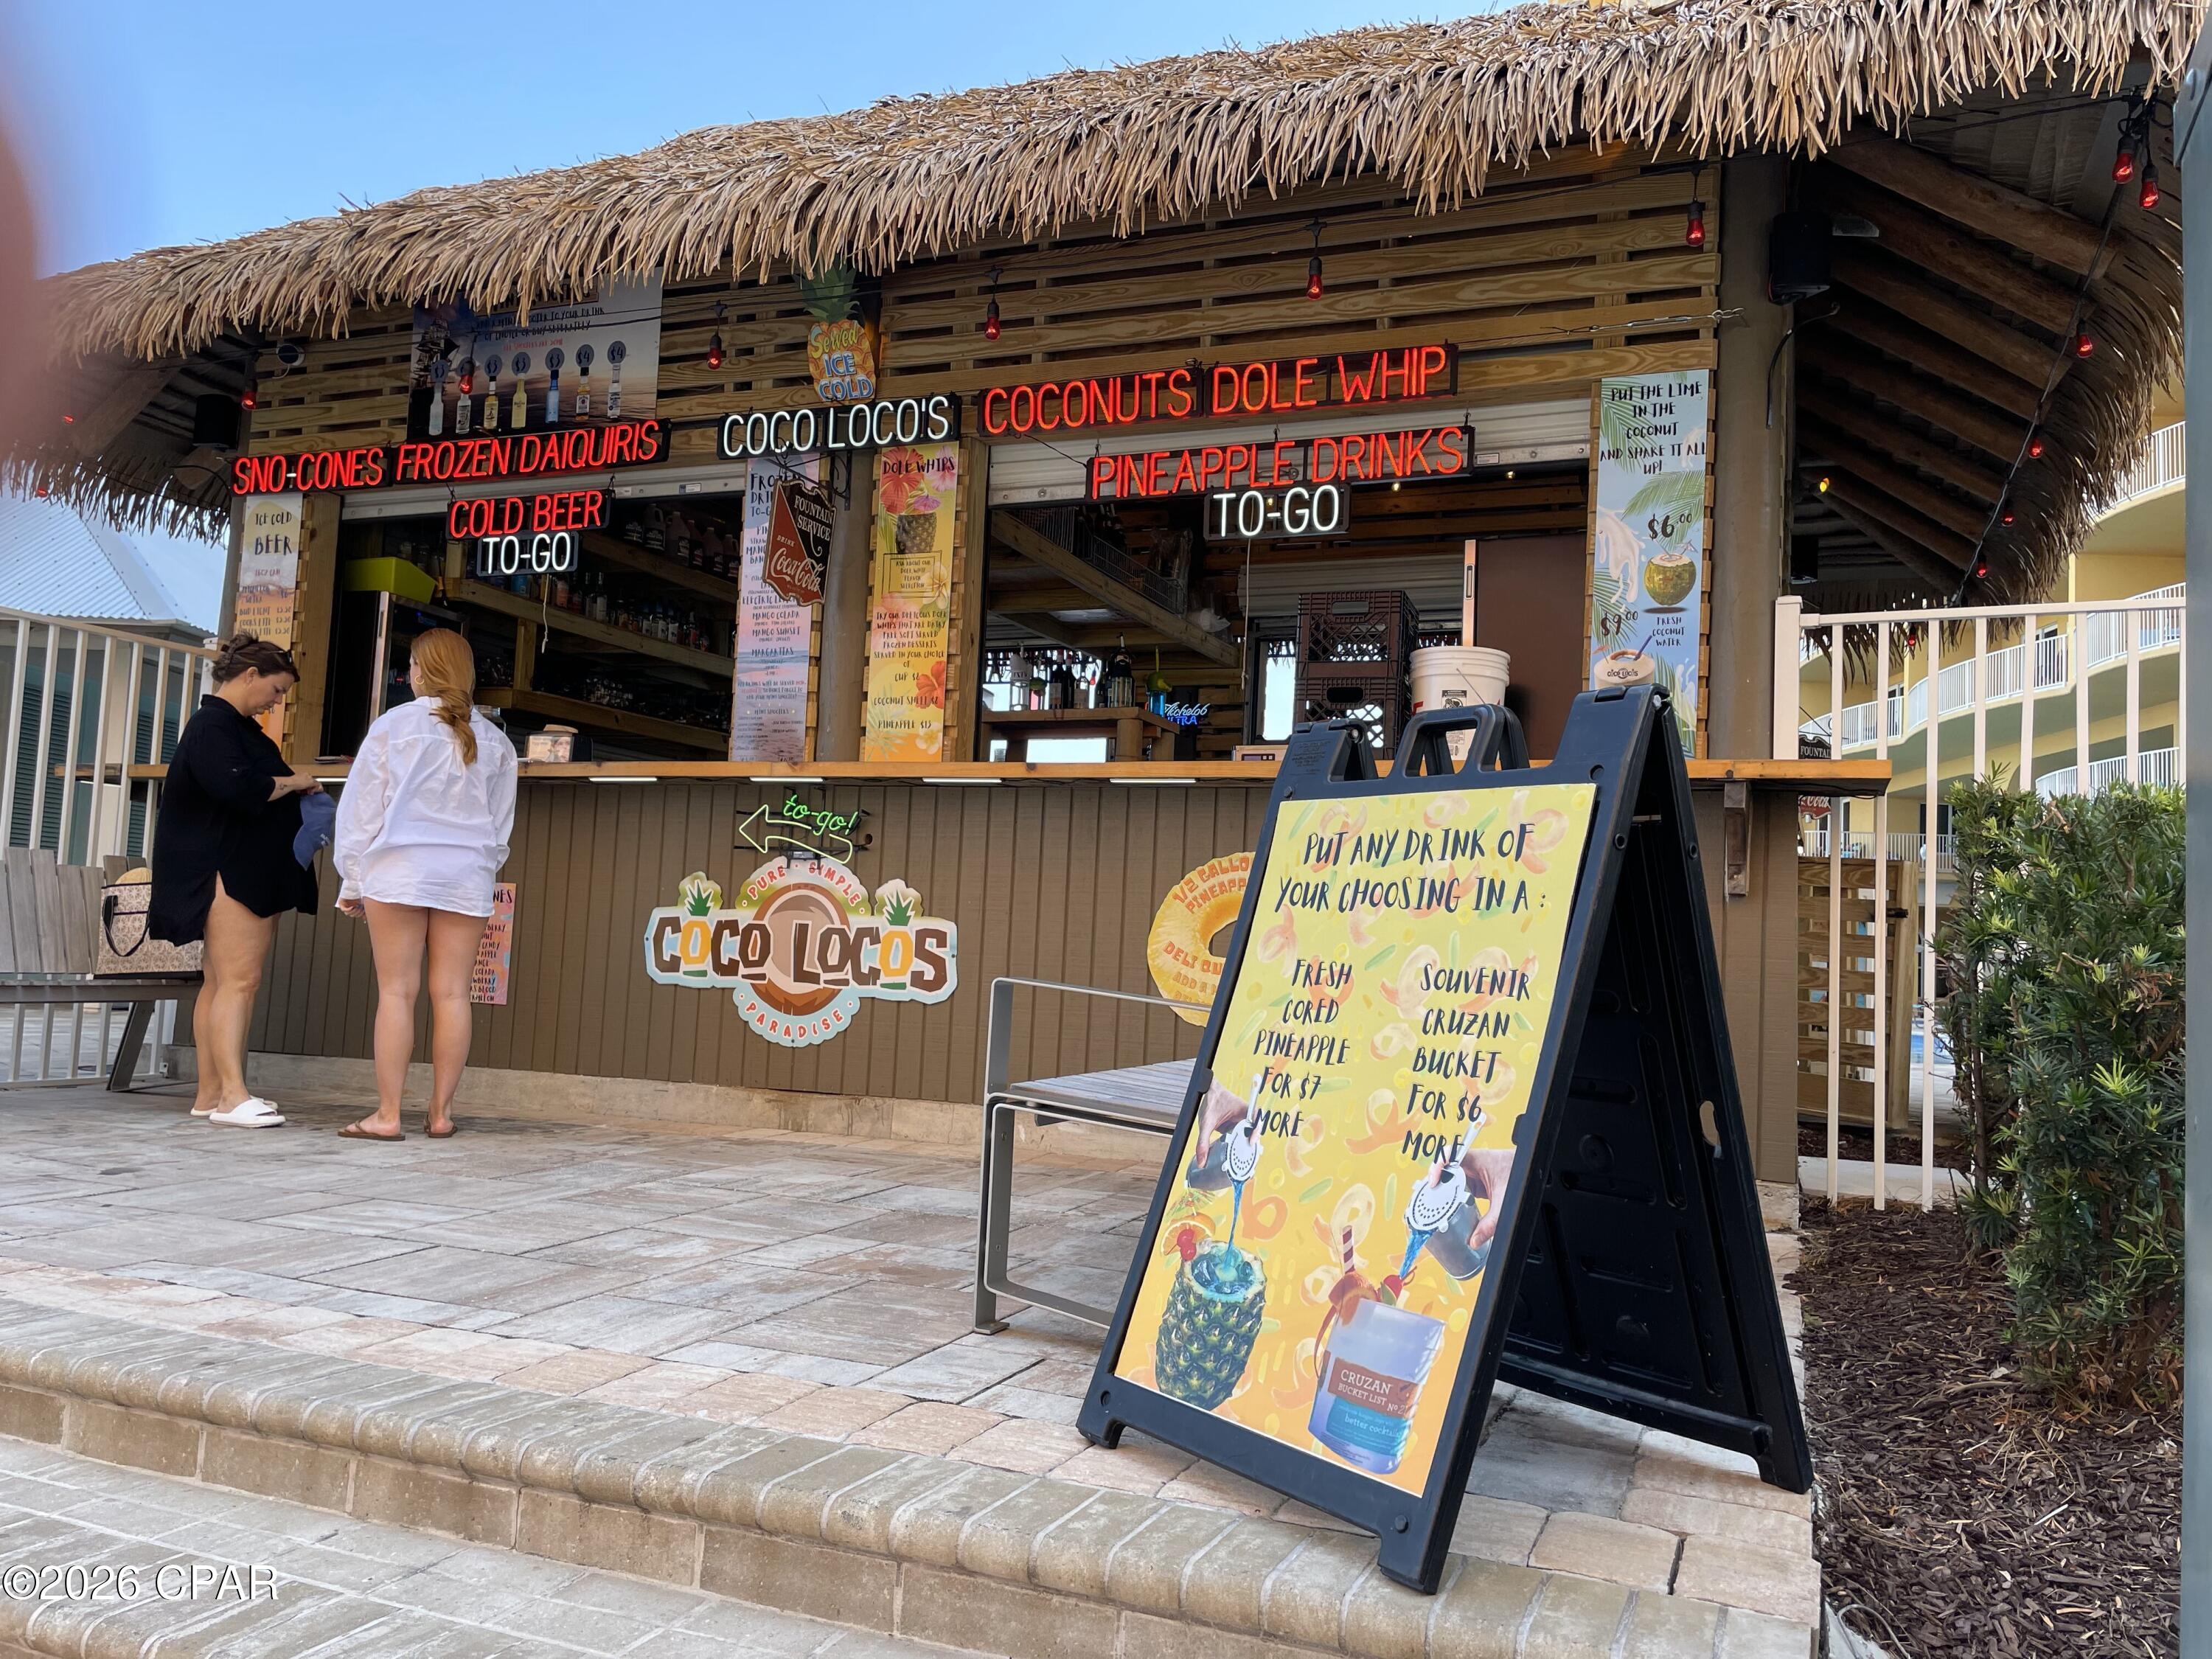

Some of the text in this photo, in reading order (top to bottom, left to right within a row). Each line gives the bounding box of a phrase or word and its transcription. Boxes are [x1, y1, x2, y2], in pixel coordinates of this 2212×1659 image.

[810, 321, 858, 359] Served
[577, 347, 591, 363] $4
[610, 346, 624, 361] $4
[822, 350, 858, 378] ICE
[818, 374, 875, 402] COLD
[1211, 344, 1447, 414] DOLE WHIP
[1611, 380, 1703, 402] PUT THE LIME
[984, 367, 1193, 436] COCONUTS
[1631, 401, 1677, 419] IN THE
[723, 395, 950, 458] COCO LOCO'S
[1626, 421, 1680, 439] COCONUT
[395, 419, 661, 481] FROZEN DAIQUIRIS
[1599, 441, 1708, 462] AND SHAKE IT ALL
[233, 447, 384, 495] SNO-CONES
[883, 456, 956, 476] DOLE WHIPS
[1091, 426, 1464, 501] PINEAPPLE DRINKS
[1643, 459, 1663, 475] UP!
[751, 490, 773, 506] DRI
[794, 494, 834, 524] FOUNTAIN
[1212, 482, 1341, 538] TO-GO
[271, 510, 293, 526] COLD
[449, 489, 603, 539] COLD BEER
[751, 506, 771, 518] TO-G
[797, 514, 831, 542] SERVICE
[1647, 512, 1693, 541] $6.00
[254, 533, 293, 557] BEER
[481, 530, 573, 575] TO-GO
[746, 546, 767, 556] MANG
[776, 534, 796, 548] DRINK
[752, 610, 801, 621] MANGO COLADA
[877, 620, 947, 630] WHIPS THAT ARE DAIRY
[888, 612, 900, 620] OUR
[902, 611, 931, 619] DELICIOUS
[932, 611, 948, 619] DOLE
[1656, 616, 1683, 626] FRESH
[752, 626, 801, 638] MANGO SUNSET
[883, 630, 939, 640] FREE SOFT SERVED
[1652, 625, 1686, 637] COCONUT
[1655, 637, 1682, 647] WATER
[751, 647, 795, 658] MARGARITAS
[873, 650, 945, 659] SERVED IN YOUR CHOICE
[883, 640, 938, 650] FROZEN DESSERTS
[902, 660, 911, 669] OF
[894, 672, 908, 683] CUP
[874, 696, 905, 706] COCONUT
[878, 720, 915, 731] PINEAPPLE
[1167, 714, 1197, 726] TRA
[1800, 745, 1832, 758] FOUNTAI
[783, 794, 859, 836] to-go!
[1303, 822, 1536, 868] PUT ANY DRINK OF
[1196, 855, 1251, 883] GALLO
[747, 860, 861, 907] PURE SIMPLE
[1185, 877, 1248, 914] PINEAPP
[1274, 876, 1330, 914] YOUR
[1337, 877, 1463, 914] CHOOSING
[1472, 875, 1506, 912] IN
[493, 888, 513, 904] NES
[484, 923, 506, 933] BERRY
[652, 914, 950, 994] COCO LOCOS
[1163, 939, 1198, 970] DELI
[473, 976, 496, 985] WBERRY
[1290, 959, 1353, 991] FRESH
[1420, 962, 1531, 1002] SOUVENIR
[745, 1000, 844, 1040] PARADISE
[1281, 997, 1340, 1026] CORED
[1422, 1007, 1512, 1039] CRUZAN
[1253, 1029, 1351, 1065] PINEAPPLE
[1412, 1046, 1503, 1085] BUCKET
[1258, 1065, 1323, 1102] FOR $7
[1405, 1082, 1483, 1123] FOR $6
[1253, 1108, 1305, 1138] MORE
[1401, 1130, 1466, 1165] MORE
[1338, 1382, 1369, 1400] BUCKET
[1368, 1393, 1388, 1406] LIST
[1340, 1368, 1394, 1396] CRUZAN
[1344, 1412, 1368, 1430] better
